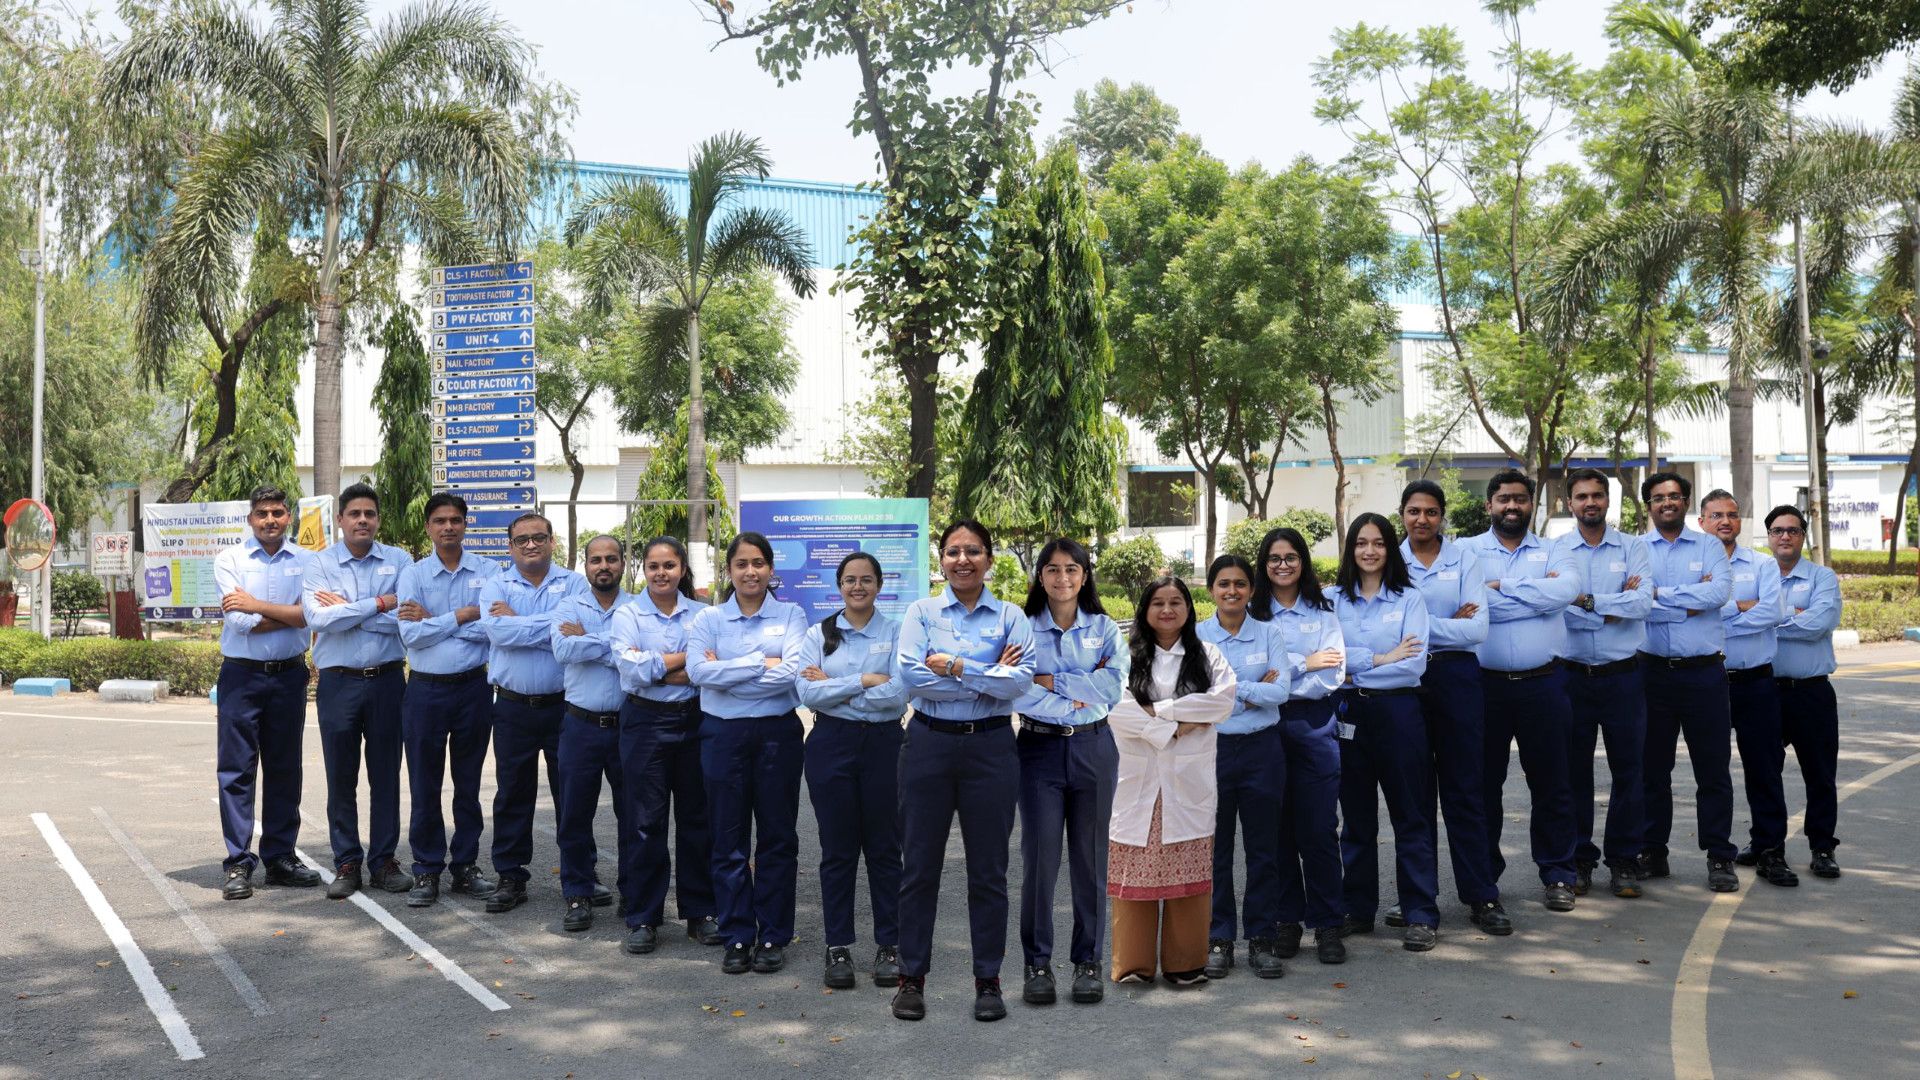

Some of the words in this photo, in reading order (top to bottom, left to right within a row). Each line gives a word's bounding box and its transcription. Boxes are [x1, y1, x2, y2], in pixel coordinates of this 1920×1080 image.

[446, 271, 469, 280] CLS-1
[470, 268, 505, 279] FACTORY
[436, 294, 441, 304] 2
[446, 291, 486, 302] TOOTHPASTE
[487, 290, 514, 300] FACTORY
[437, 315, 444, 326] 3
[451, 315, 467, 325] PW
[469, 311, 513, 324] FACTORY
[437, 337, 444, 347] 4
[465, 334, 499, 345] UNIT-4
[437, 359, 442, 369] 5
[447, 360, 463, 368] NAIL
[464, 358, 495, 367] FACTORY
[438, 381, 444, 392] 6
[447, 380, 477, 390] COLOR
[479, 377, 518, 389] FACTORY
[437, 404, 442, 414] 7
[447, 404, 463, 412] NMB
[464, 402, 495, 411] FACTORY
[437, 426, 443, 436] 8
[447, 426, 467, 435] CLS-2
[468, 425, 499, 434] FACTORY
[437, 449, 443, 459] 9
[447, 449, 457, 457] HR
[458, 448, 482, 457] OFFICE
[436, 470, 445, 480] 10
[448, 470, 488, 479] ADMINISTRATIVE
[489, 469, 521, 478] DEPARTMENT
[474, 492, 508, 501] ASSURANCE
[1848, 501, 1879, 512] FACTORY
[147, 518, 188, 527] HINDUSTAN
[189, 516, 226, 525] UNILEVER
[227, 515, 247, 524] LIMIT
[824, 514, 853, 522] ACTION
[145, 549, 176, 558] Campaign
[192, 549, 204, 557] May
